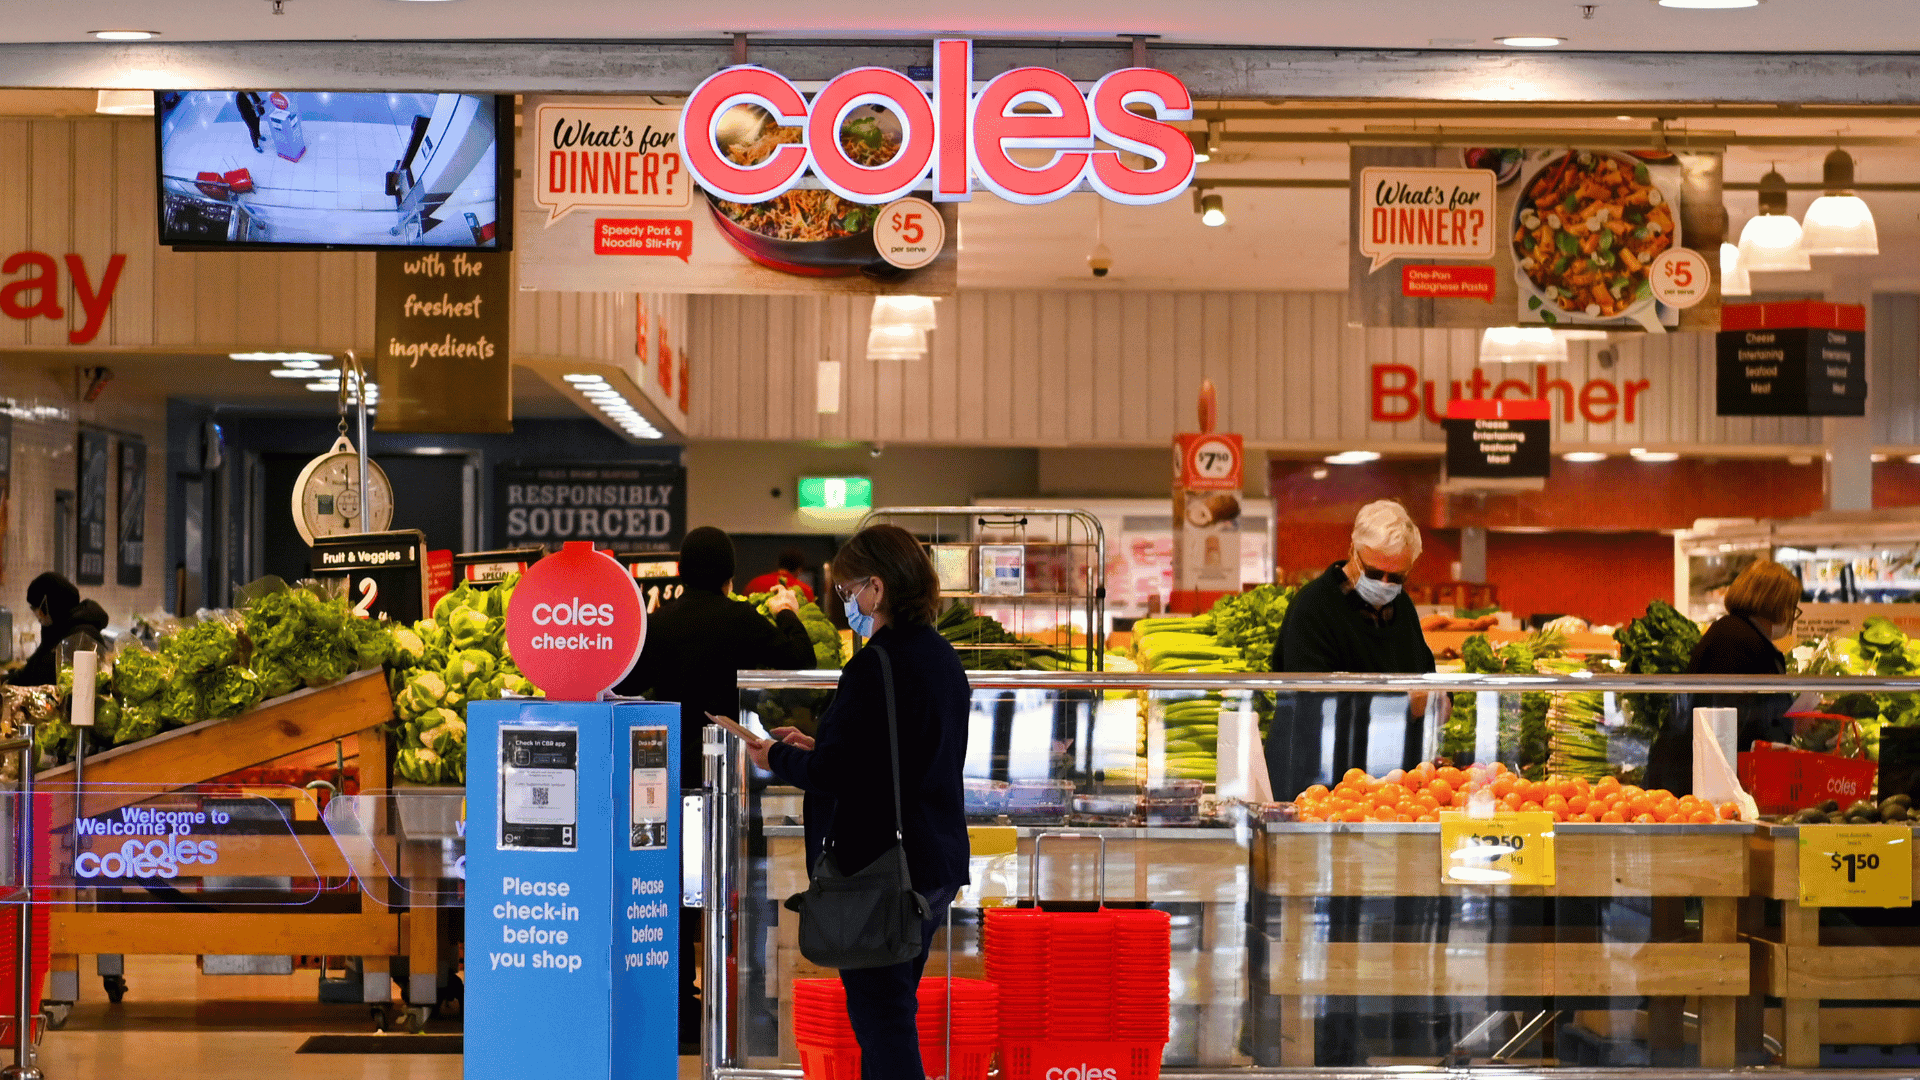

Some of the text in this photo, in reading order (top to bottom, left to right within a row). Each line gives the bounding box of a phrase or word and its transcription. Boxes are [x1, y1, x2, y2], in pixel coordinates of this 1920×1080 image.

[678, 38, 1196, 205] coles
[553, 117, 675, 157] What's for
[549, 151, 680, 196] DINNER?
[1375, 179, 1481, 213] What's for
[601, 223, 683, 238] Speedy Pork &
[892, 212, 924, 244] $5
[1372, 208, 1485, 246] DINNER?
[601, 237, 682, 251] Noodle Stir-Fry
[891, 246, 902, 254] per
[403, 254, 483, 277] with the
[1409, 270, 1451, 280] One-Pan
[1664, 259, 1693, 288] $5
[1409, 281, 1488, 293] Bolognese Pasta
[403, 292, 483, 318] freshest
[1745, 332, 1776, 344] Cheese
[389, 335, 495, 368] ingredients
[1738, 348, 1784, 363] Entertaining
[1370, 363, 1651, 423] Butcher
[1475, 419, 1510, 430] Cheese
[1472, 431, 1526, 443] Entertaining
[1479, 443, 1518, 453] Seafood
[507, 484, 673, 505] RESPONSIBLY
[506, 508, 671, 537] SOURCED
[323, 550, 401, 565] Fruit & Veggies
[532, 597, 615, 627] coles
[531, 632, 614, 651] check-in
[1827, 776, 1857, 796] coles
[121, 807, 230, 825] Welcome to
[76, 817, 191, 836] Welcome to
[75, 843, 179, 879] coles
[1511, 854, 1524, 865] kg
[502, 876, 570, 897] Please
[631, 877, 664, 895] Please
[493, 901, 579, 921] check-in
[626, 900, 668, 920] check-in
[503, 926, 569, 945] before
[631, 925, 664, 943] before
[489, 950, 582, 973] you shop
[625, 949, 669, 971] you shop
[1045, 1063, 1117, 1080] coles
